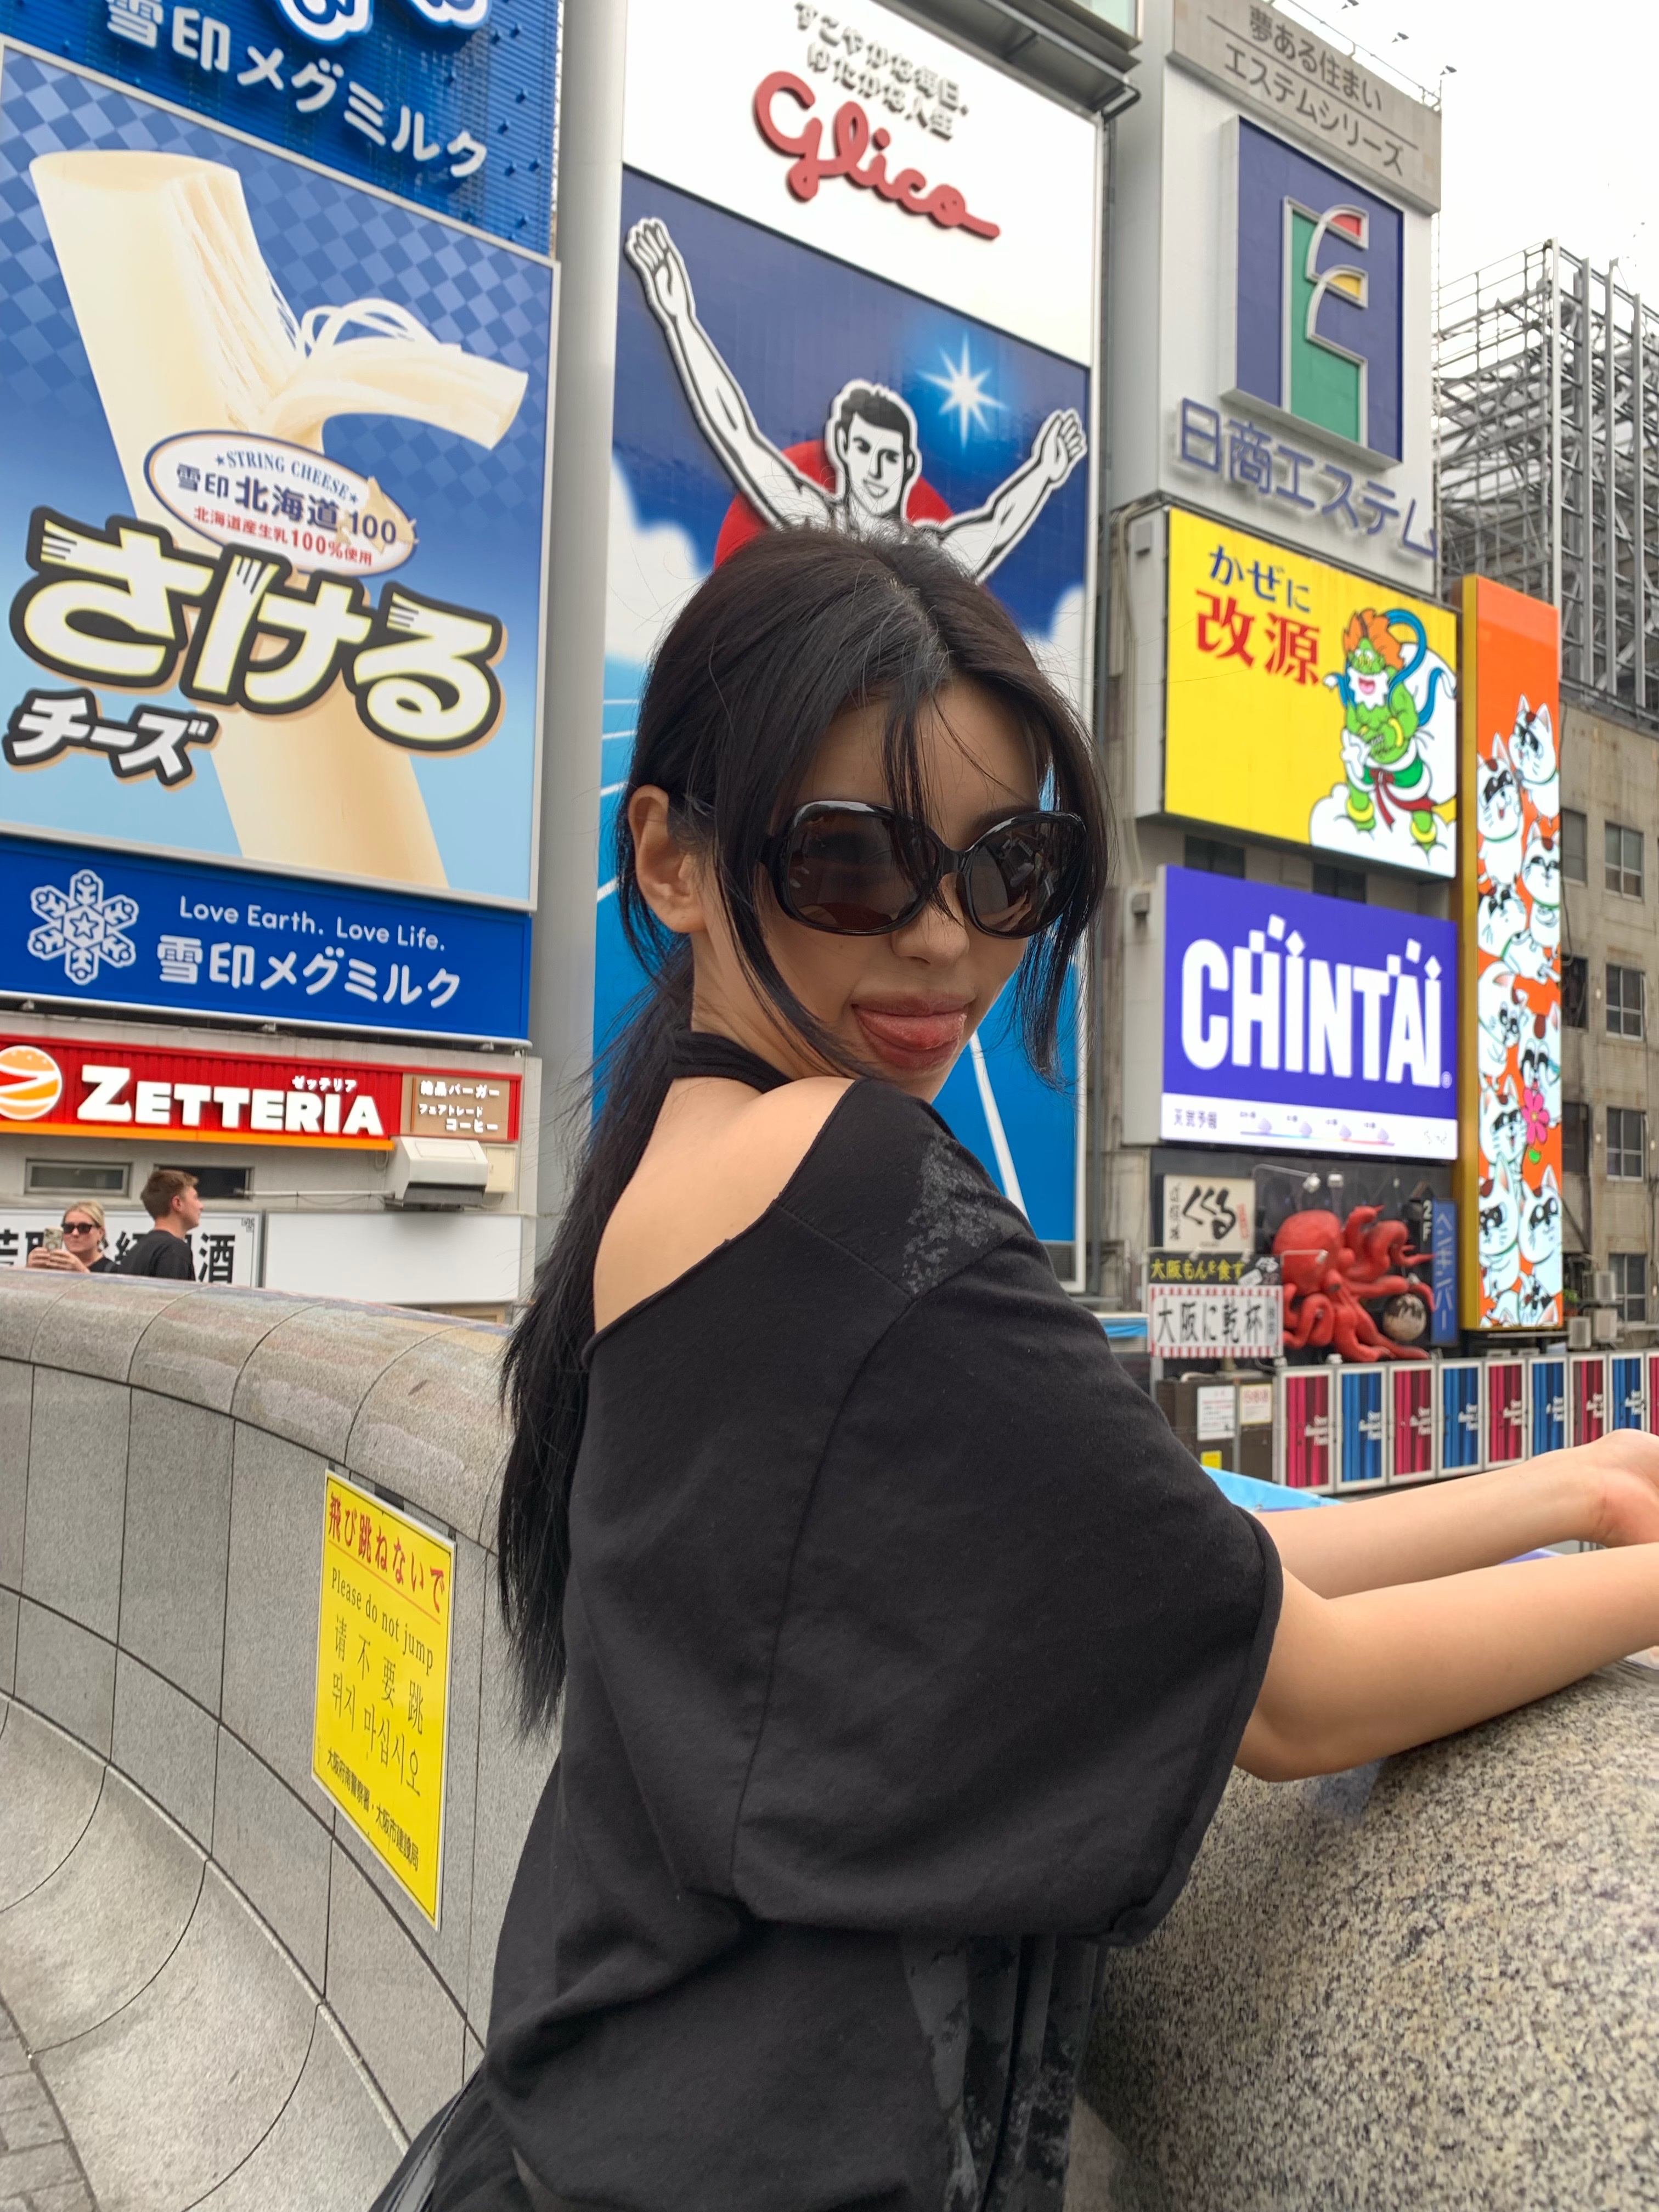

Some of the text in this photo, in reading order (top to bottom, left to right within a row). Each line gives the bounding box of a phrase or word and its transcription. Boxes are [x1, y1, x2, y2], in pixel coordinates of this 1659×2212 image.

[108, 0, 487, 177] 雪印メグミルク
[1249, 4, 1383, 111] 夢ある住まい
[752, 70, 1000, 241] Glico
[1224, 43, 1403, 176] エステムシリーズ
[226, 450, 350, 500] STRING CHEESE
[1179, 397, 1438, 560] 日商エステム
[194, 506, 373, 566] 北海道産生乳100%使用
[1208, 545, 1311, 613] かぜに
[15, 510, 498, 746] さける
[1195, 589, 1320, 686] 改源
[8, 692, 214, 781] チーズ
[180, 896, 445, 951] Love Earth. Love Life.
[157, 934, 460, 1008] 雪印メグミルク
[77, 1065, 383, 1136] ZETTERIA
[292, 1075, 357, 1093] ゼッテリア
[445, 1118, 498, 1133] コーヒー
[1156, 1297, 1262, 1344] 大阪に乾杯
[329, 1492, 445, 1613] 飛び跳ねないで
[332, 1567, 433, 1676] Please do not jump
[332, 1672, 421, 1797] 뛰지 마십시오
